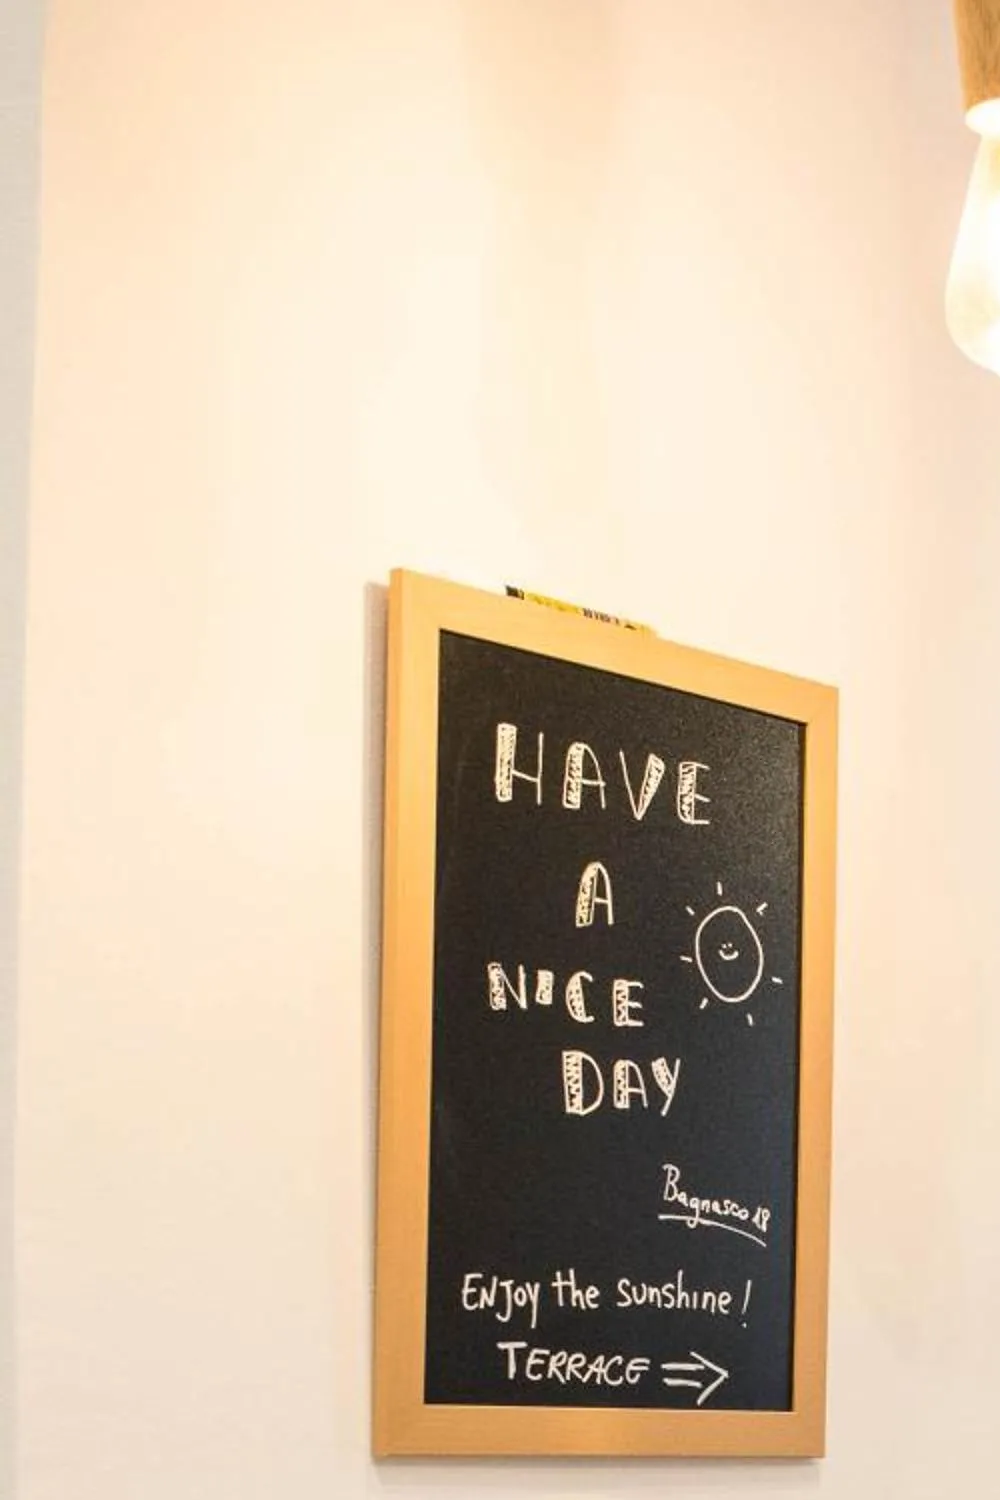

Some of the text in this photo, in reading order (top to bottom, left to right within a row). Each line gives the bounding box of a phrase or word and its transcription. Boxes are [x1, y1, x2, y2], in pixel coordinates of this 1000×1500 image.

[494, 722, 711, 826] HAVE
[575, 861, 615, 928] A
[487, 961, 645, 1028] NICE
[562, 1050, 681, 1117] DAY
[551, 1268, 600, 1310] the
[496, 1341, 651, 1386] TERRACE
